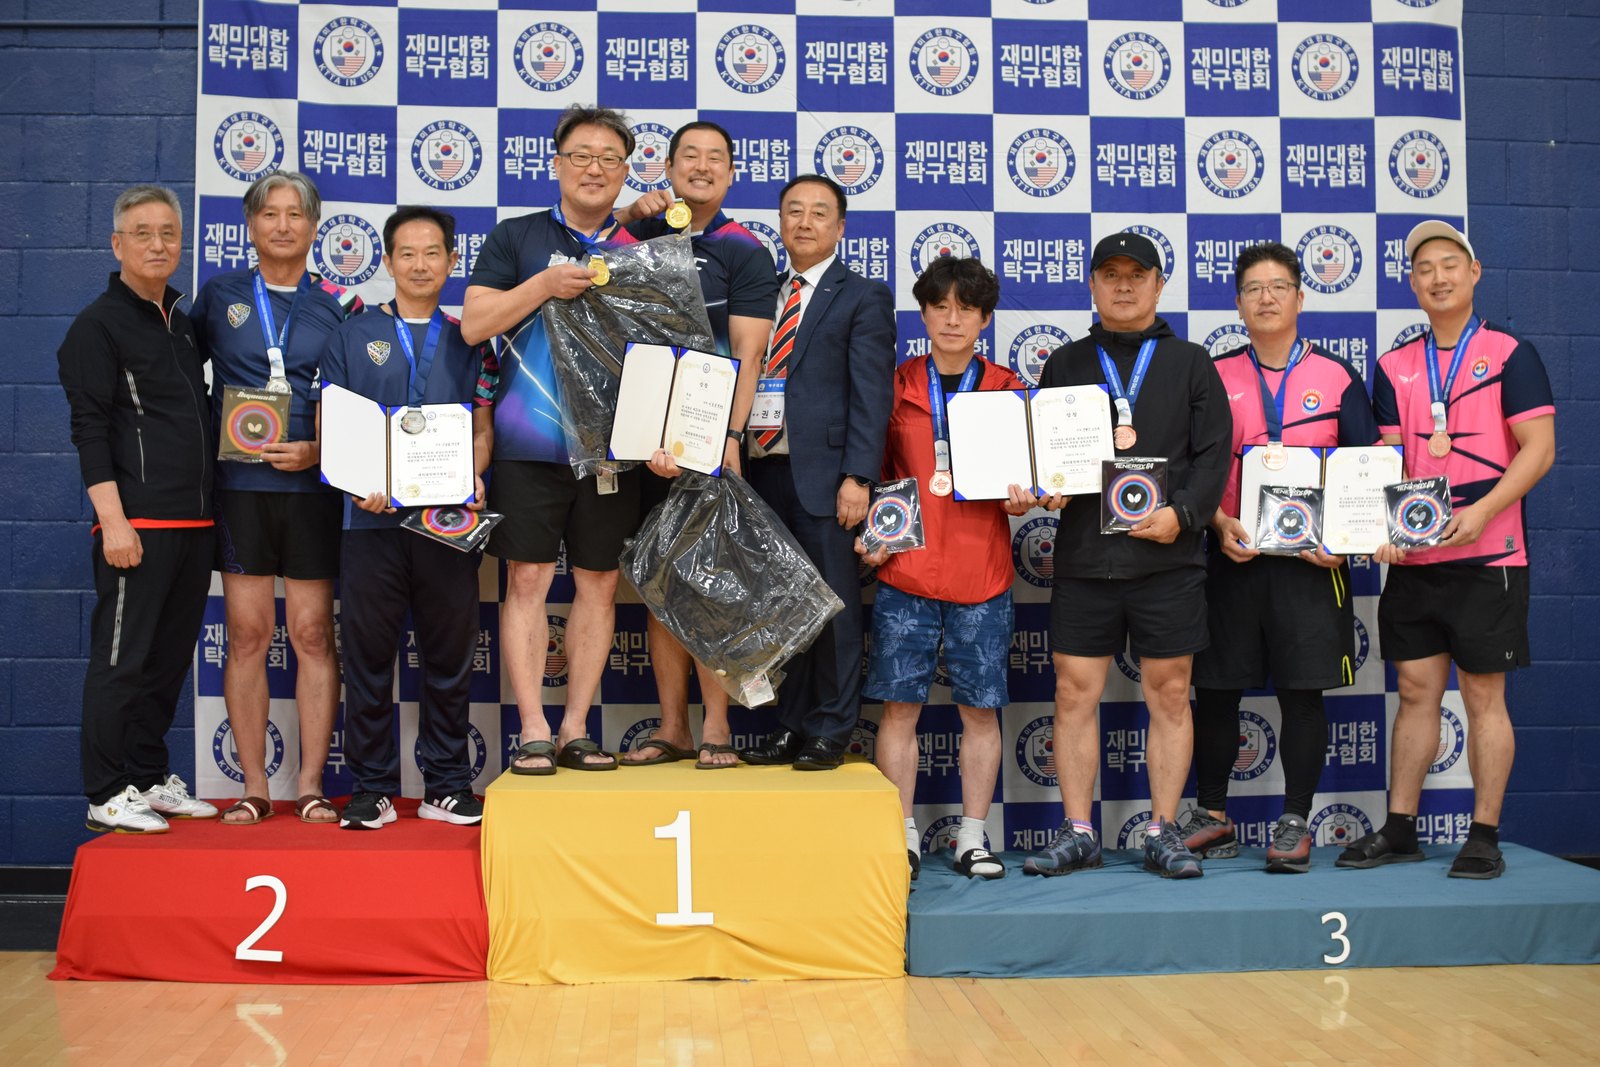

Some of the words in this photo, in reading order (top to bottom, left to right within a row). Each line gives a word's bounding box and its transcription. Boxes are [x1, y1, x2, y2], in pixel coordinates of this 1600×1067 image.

[208, 24, 290, 50] 재미대한
[405, 34, 490, 57] 재미대한
[208, 46, 288, 71] 탁구협회
[606, 38, 689, 60] 재미대한
[805, 41, 888, 62] 재미대한
[1000, 44, 1082, 66] 재미대한
[1192, 48, 1270, 69] 재미대한
[1382, 47, 1453, 70] 재미대한
[319, 64, 340, 84] KTTA
[360, 65, 378, 82] USA
[406, 56, 488, 79] 탁구협회
[606, 59, 688, 81] 탁구협회
[806, 62, 887, 84] 탁구협회
[1001, 65, 1081, 88] 탁구협회
[520, 70, 540, 90] KTTA
[560, 70, 579, 87] USA
[721, 71, 743, 91] KTTA
[763, 72, 781, 89] USA
[915, 74, 936, 94] KTTA
[956, 74, 974, 92] USA
[1110, 77, 1130, 97] KTTA
[1149, 78, 1168, 96] USA
[1192, 68, 1270, 90] 탁구협회
[1297, 80, 1318, 100] KTTA
[1337, 80, 1354, 96] USA
[1382, 69, 1453, 93] 탁구협회
[303, 130, 388, 155] 재미대한
[504, 136, 557, 158] 재미
[732, 138, 791, 160] 미대한
[905, 140, 988, 162] 재미대한
[304, 151, 386, 177] 탁구협회
[1096, 144, 1177, 165] 재미대한
[1286, 144, 1367, 166] 재미대한
[220, 158, 240, 180] KTTA
[418, 168, 439, 188] KTTA
[459, 168, 478, 186] USA
[504, 157, 558, 180] 탁구
[906, 162, 987, 184] 탁구협회
[1097, 165, 1176, 187] 탁구협회
[1287, 165, 1366, 188] 탁구협회
[626, 176, 641, 190] TTA
[862, 174, 880, 190] USA
[1013, 174, 1034, 194] KTTA
[1053, 175, 1071, 192] USA
[1203, 176, 1224, 196] KTTA
[1243, 176, 1261, 194] USA
[1394, 176, 1412, 196] KTTA
[1418, 189, 1428, 197] IN
[1431, 178, 1448, 194] USA
[205, 223, 250, 246] 재미
[1002, 239, 1084, 261] 재미대한
[318, 262, 340, 283] KTTA
[360, 264, 378, 281] USA
[1003, 261, 1084, 283] 탁구협회
[1300, 272, 1321, 291] KTTA
[1340, 272, 1358, 288] USA
[1012, 326, 1070, 352] 재미대한탁구협
[1018, 566, 1040, 584] KTTA
[204, 624, 288, 647] 재한
[612, 632, 650, 653] 재미
[1011, 631, 1048, 652] 재미
[204, 646, 287, 670] 탁회
[611, 653, 650, 675] 탁구
[1011, 652, 1050, 674] 탁구
[918, 733, 959, 754] 재미
[1107, 729, 1146, 750] 재미
[918, 755, 959, 776] 탁구
[1107, 751, 1147, 773] 탁구
[1256, 758, 1271, 775] USA
[1443, 751, 1460, 768] USA
[471, 766, 481, 778] SA
[1021, 766, 1043, 784] KTTA
[1416, 813, 1472, 835] 미대한
[1013, 829, 1057, 850] 재미
[654, 810, 714, 926] 1
[235, 875, 288, 962] 2
[1320, 911, 1351, 965] 3
